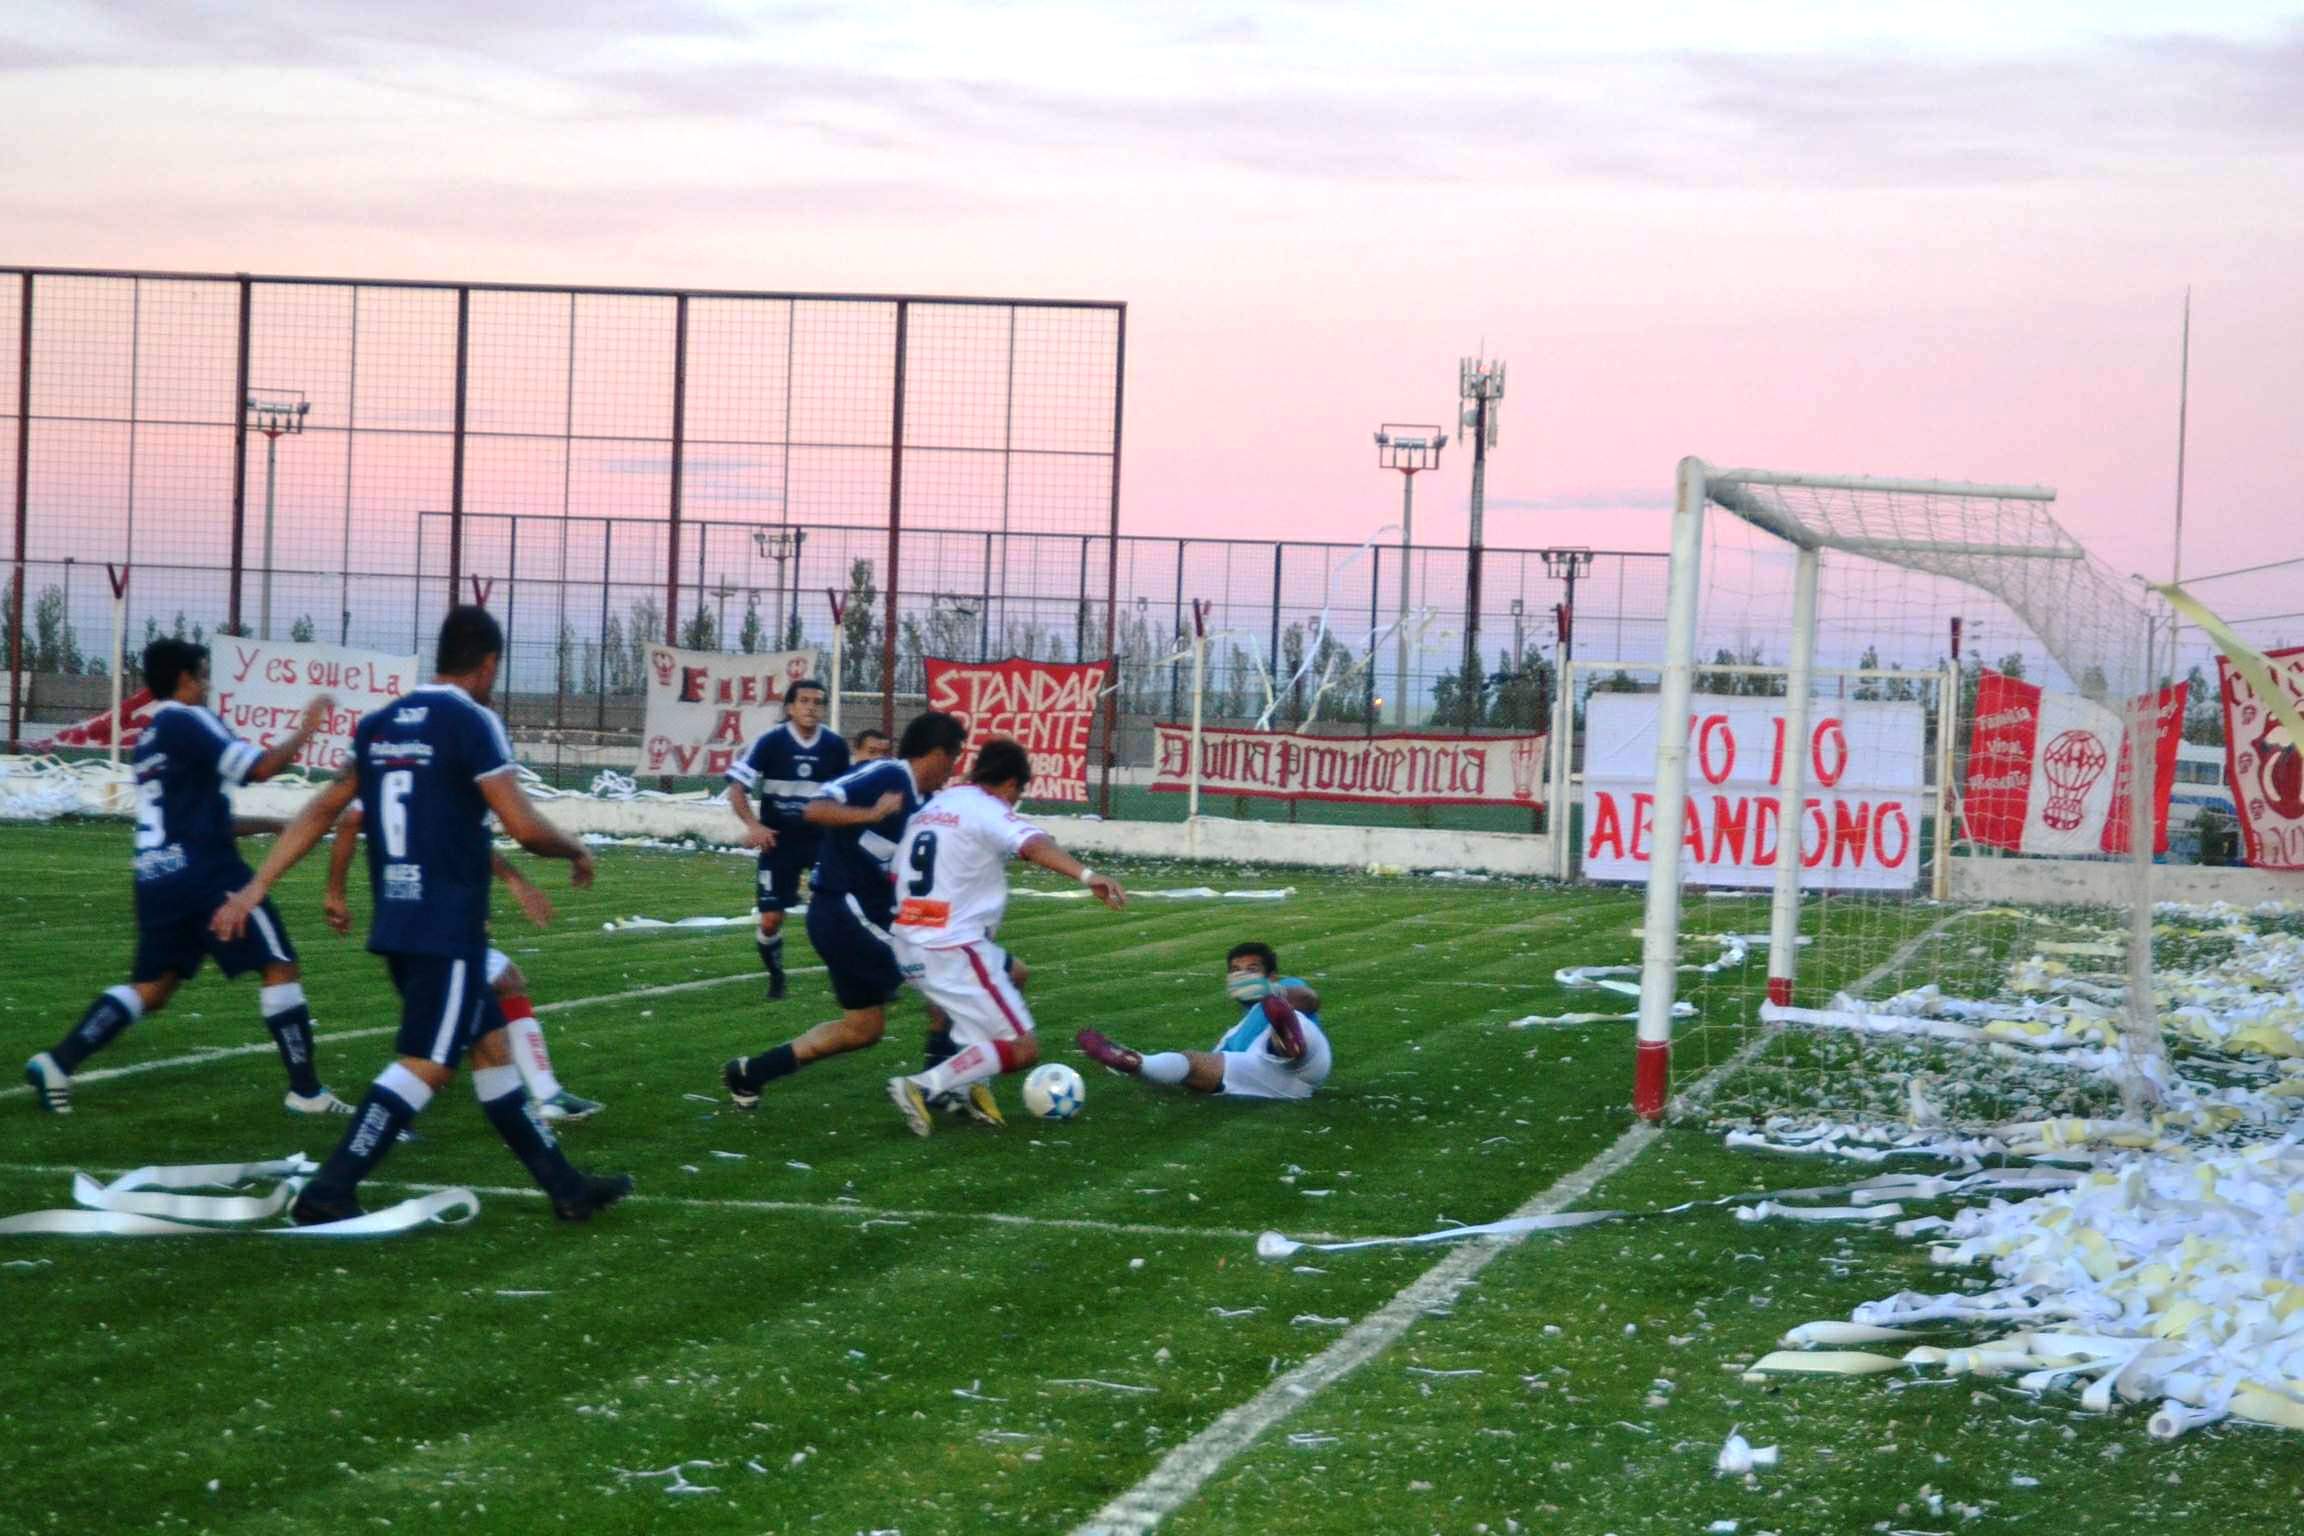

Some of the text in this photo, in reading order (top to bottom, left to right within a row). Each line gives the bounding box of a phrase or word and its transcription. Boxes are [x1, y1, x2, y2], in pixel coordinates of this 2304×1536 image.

[367, 661, 400, 696] La
[218, 692, 300, 729] Fuerz
[706, 710, 744, 745] A
[673, 744, 746, 777] VO
[1066, 754, 1086, 779] Y
[908, 830, 937, 897] 9
